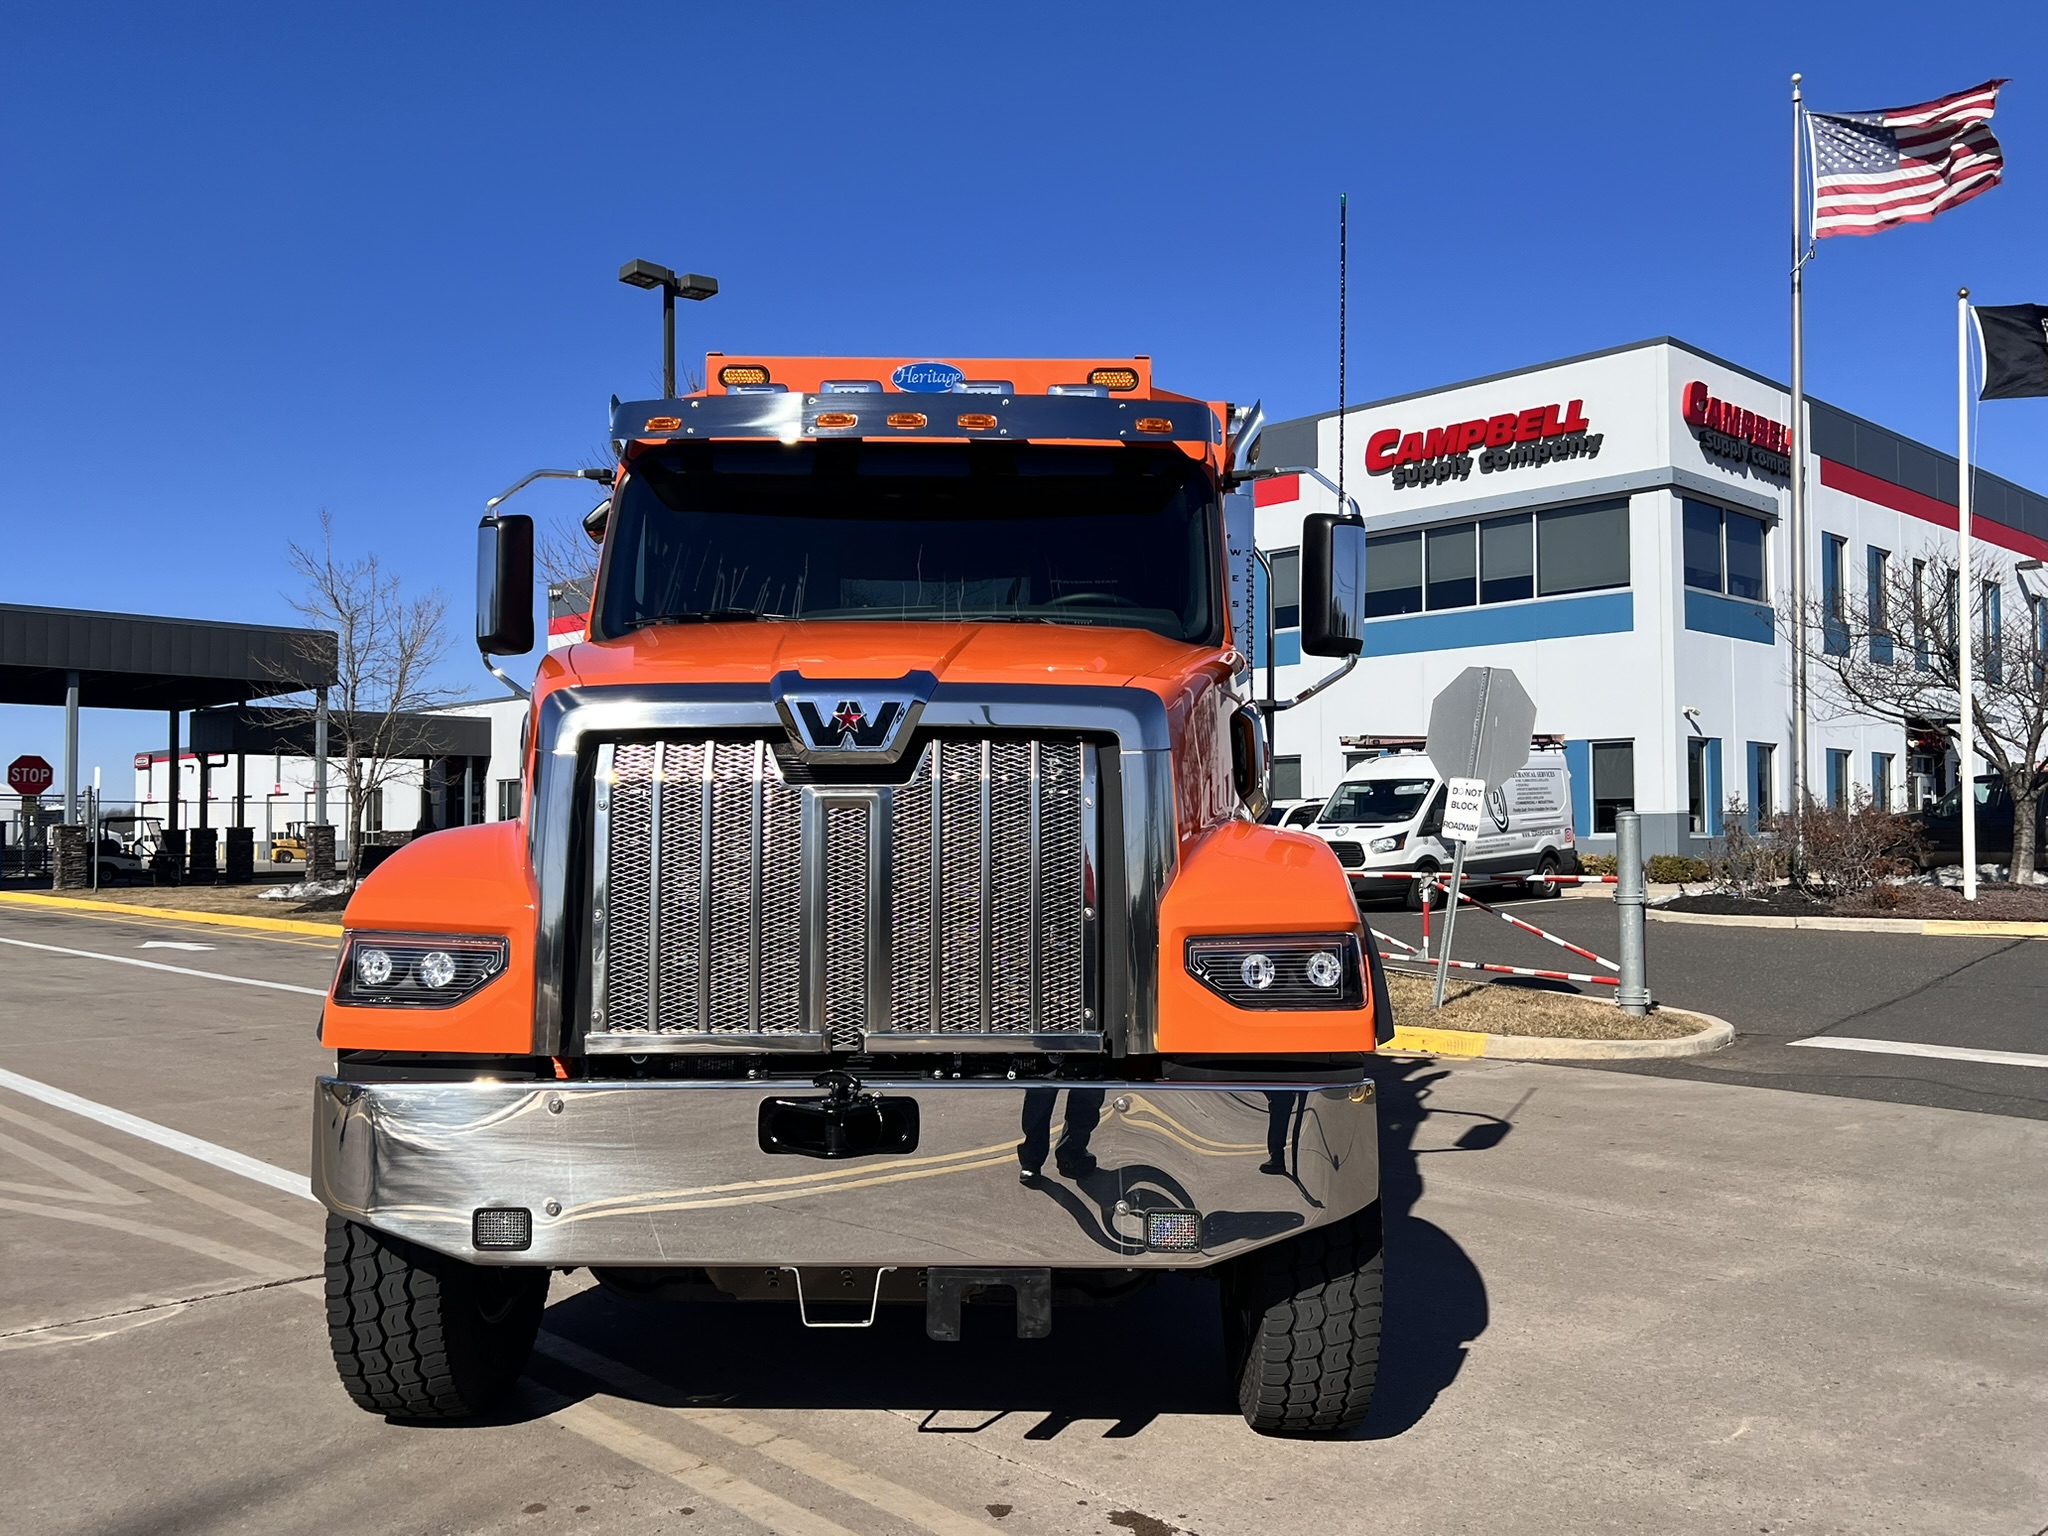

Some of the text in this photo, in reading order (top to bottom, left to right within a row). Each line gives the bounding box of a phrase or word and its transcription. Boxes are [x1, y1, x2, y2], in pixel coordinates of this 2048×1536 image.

[894, 365, 962, 388] Heritage
[1682, 380, 1791, 457] CAMPBEL
[1365, 398, 1590, 475] CAMPBELL
[10, 767, 51, 783] STOP
[1452, 787, 1483, 798] DO NOT
[1450, 800, 1479, 811] BLOCK
[1442, 820, 1479, 832] ROADWAY
